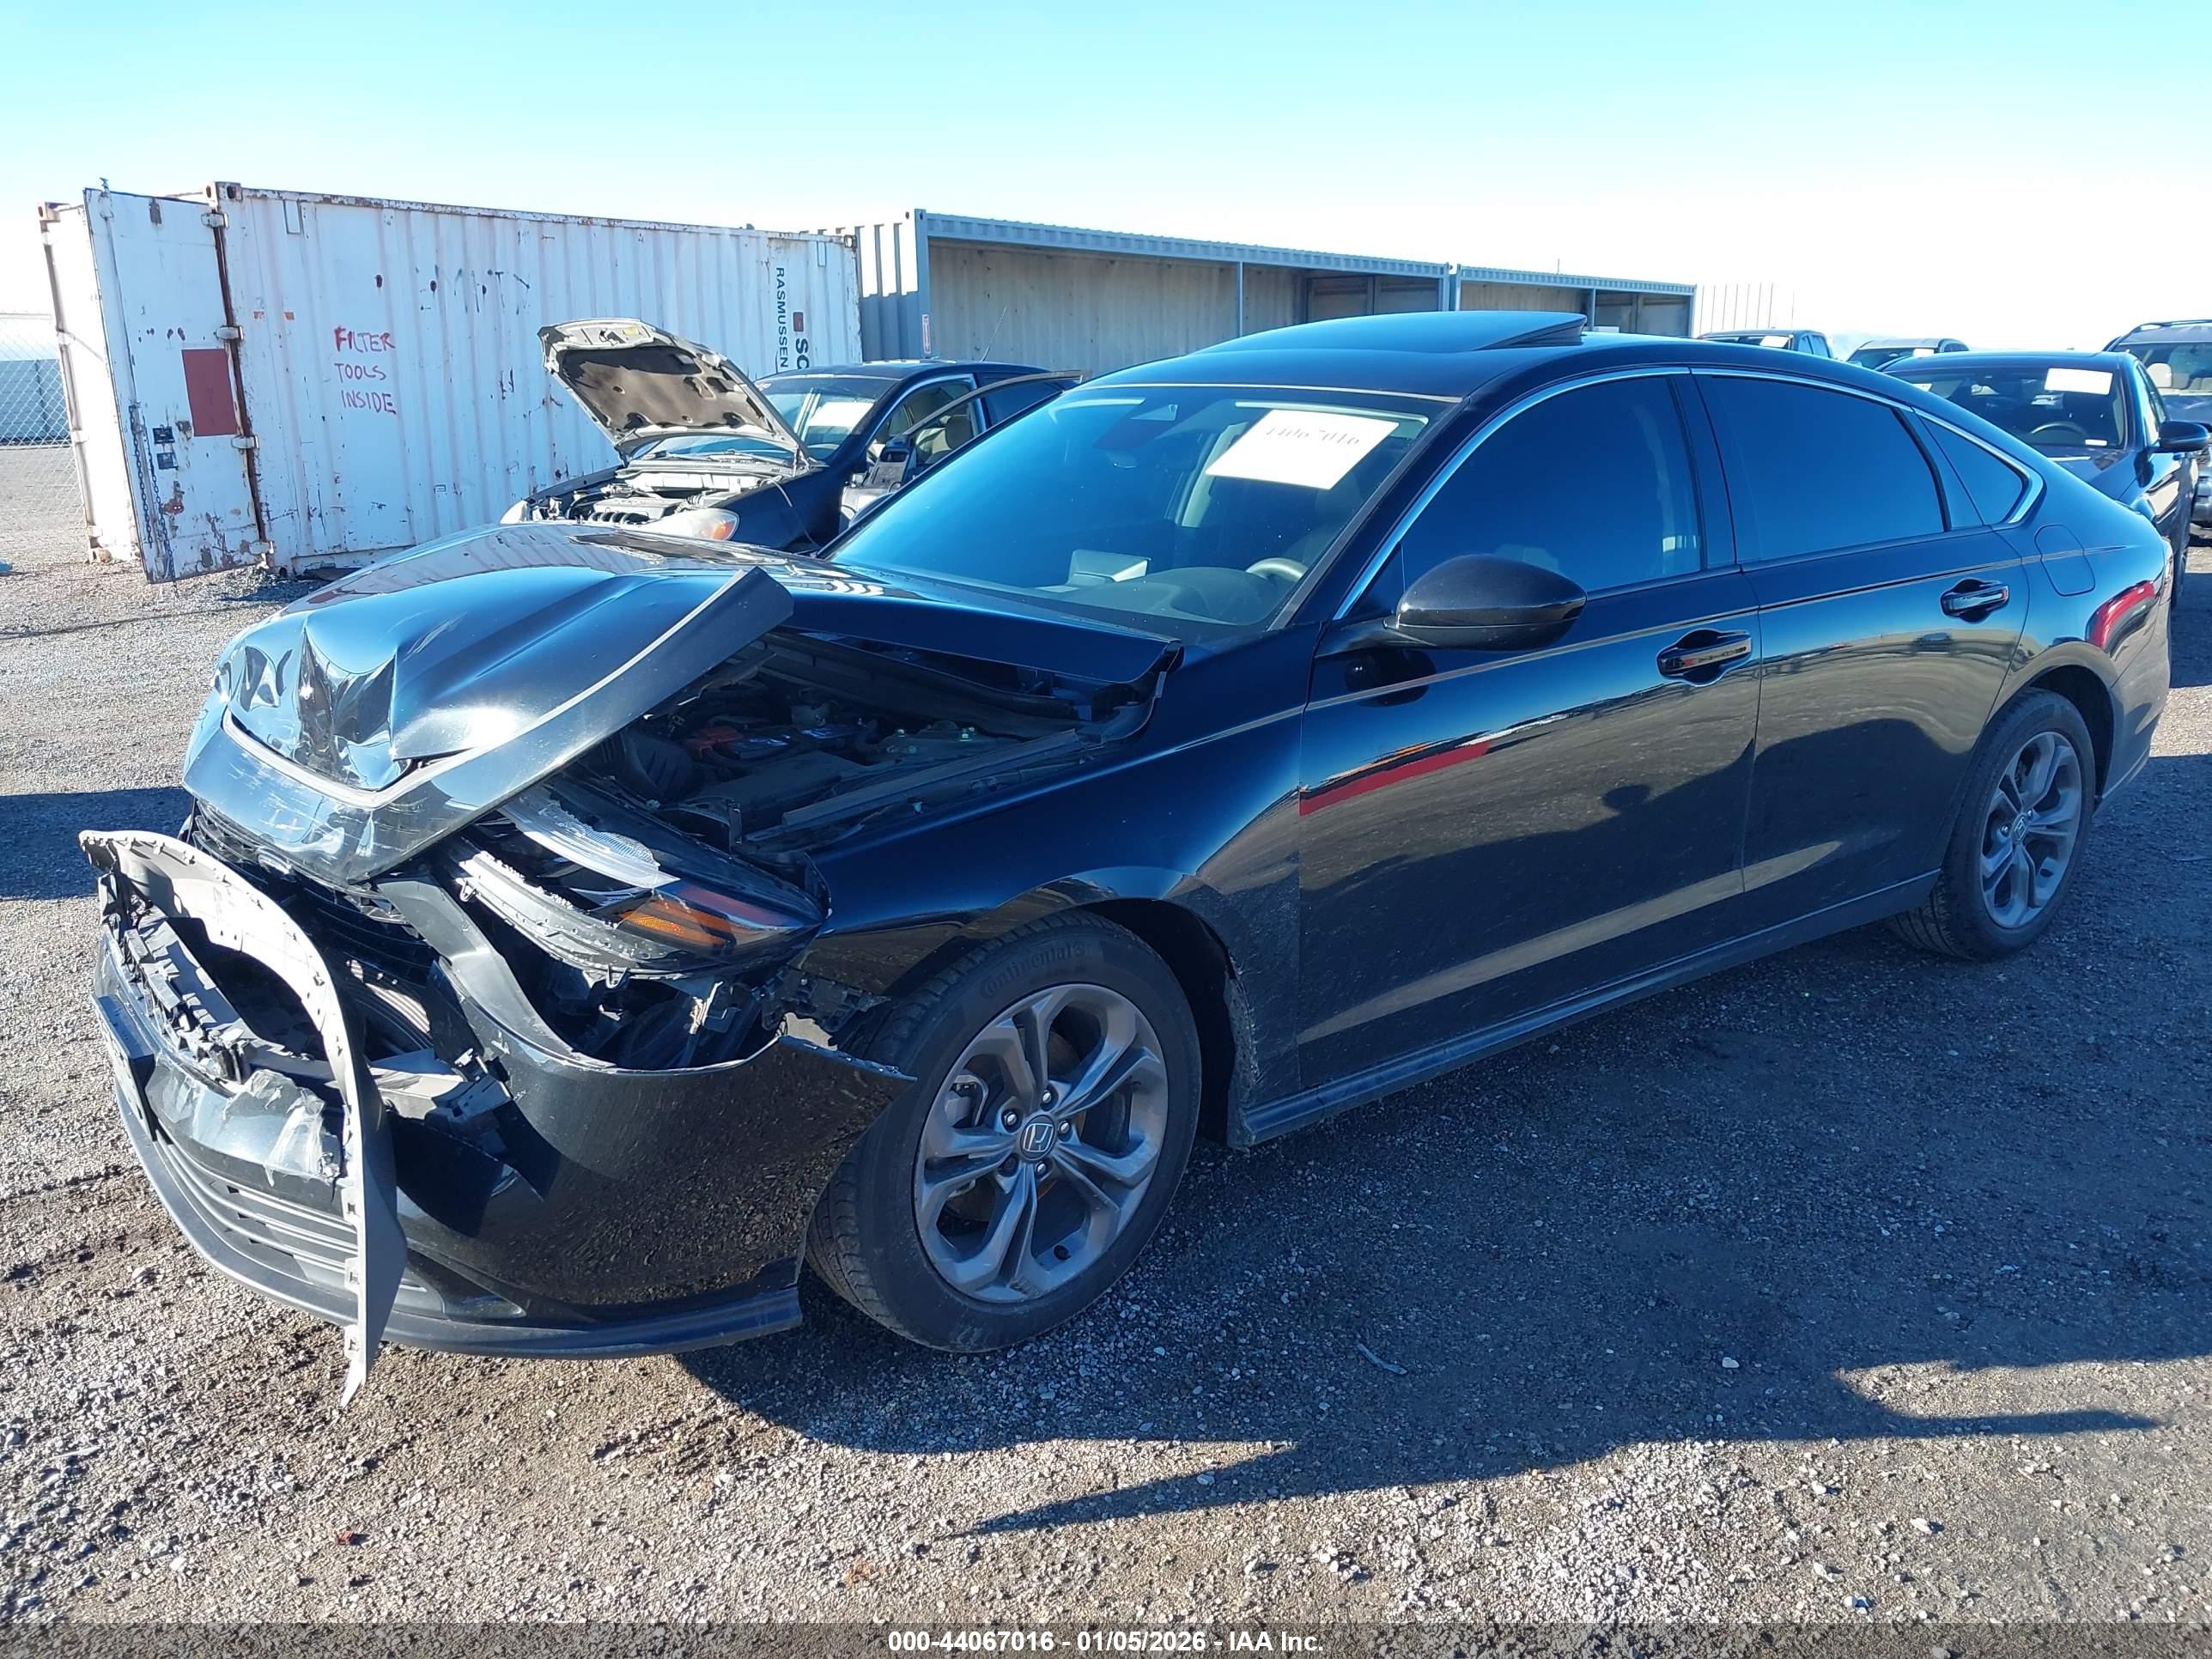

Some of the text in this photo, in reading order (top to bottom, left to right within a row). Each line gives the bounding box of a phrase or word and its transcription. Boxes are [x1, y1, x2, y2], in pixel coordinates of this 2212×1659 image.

[775, 267, 789, 368] RASMUSSEN
[333, 326, 396, 353] FILTER
[334, 362, 386, 383] TOOLS
[341, 390, 397, 414] INSIDE
[982, 943, 1072, 997] Continental
